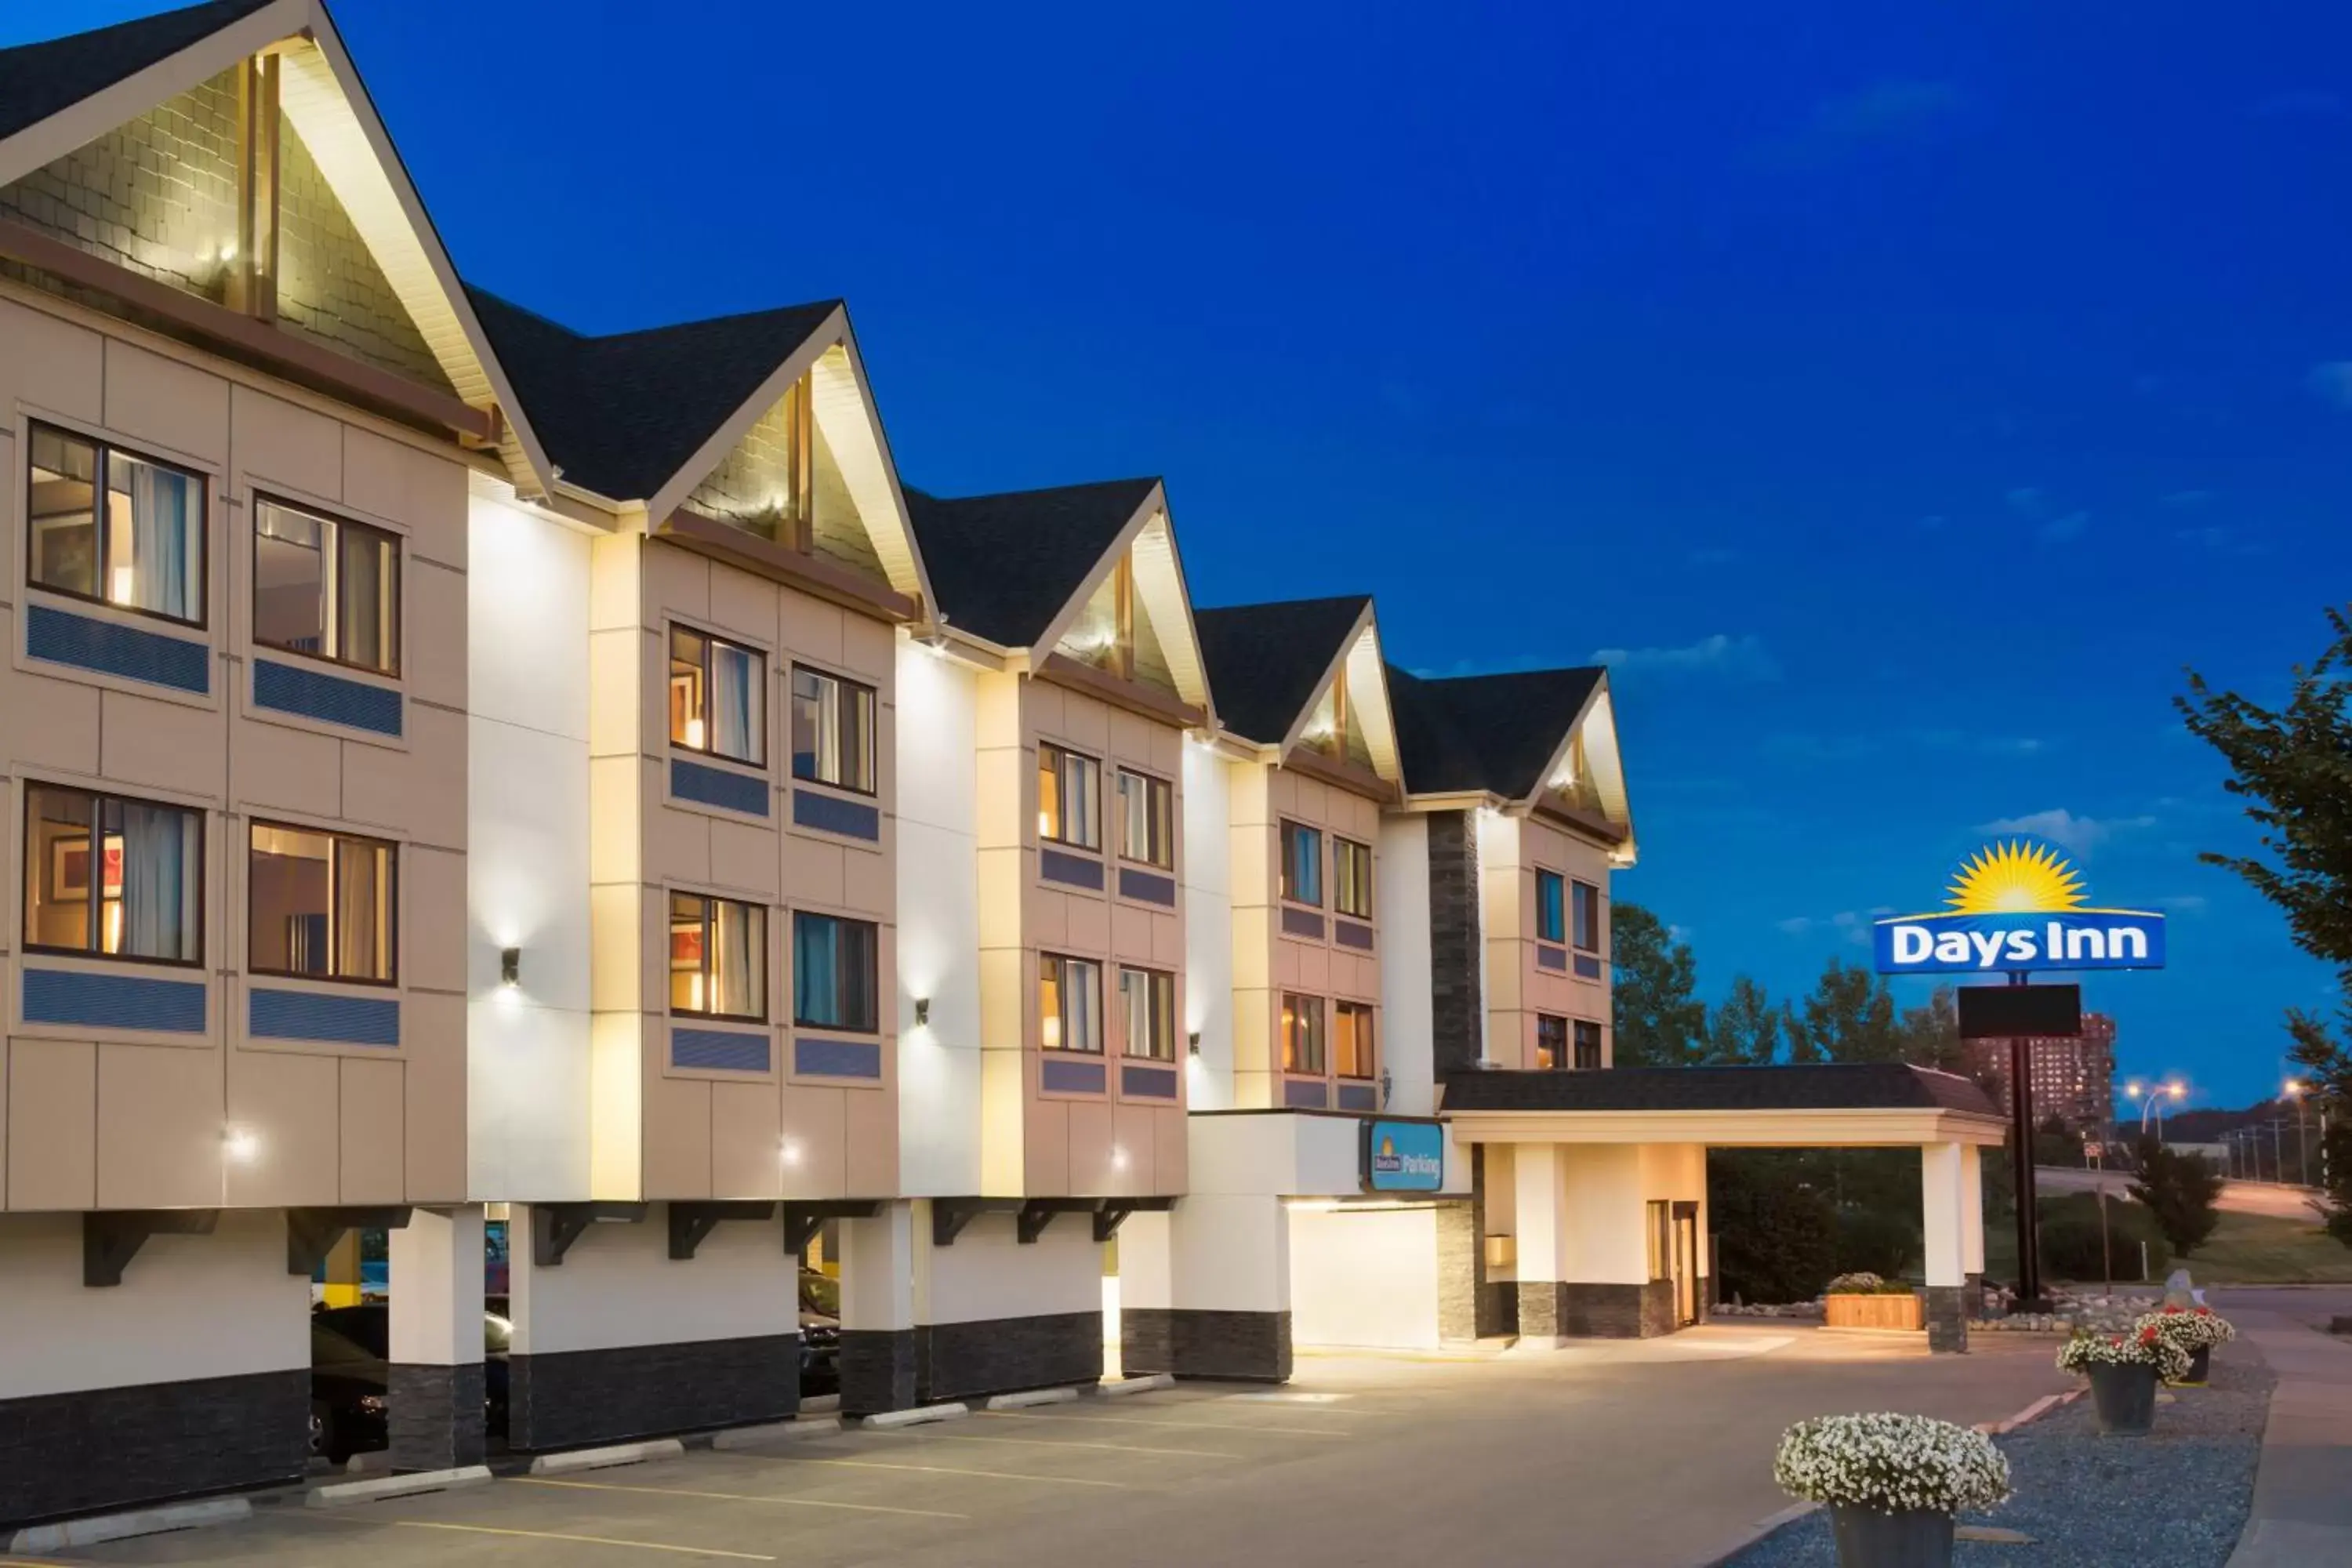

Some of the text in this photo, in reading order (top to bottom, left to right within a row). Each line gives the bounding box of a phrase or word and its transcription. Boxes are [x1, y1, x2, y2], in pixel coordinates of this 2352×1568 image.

[1892, 921, 2147, 967] Days Inn
[1402, 1154, 1440, 1180] Parking
